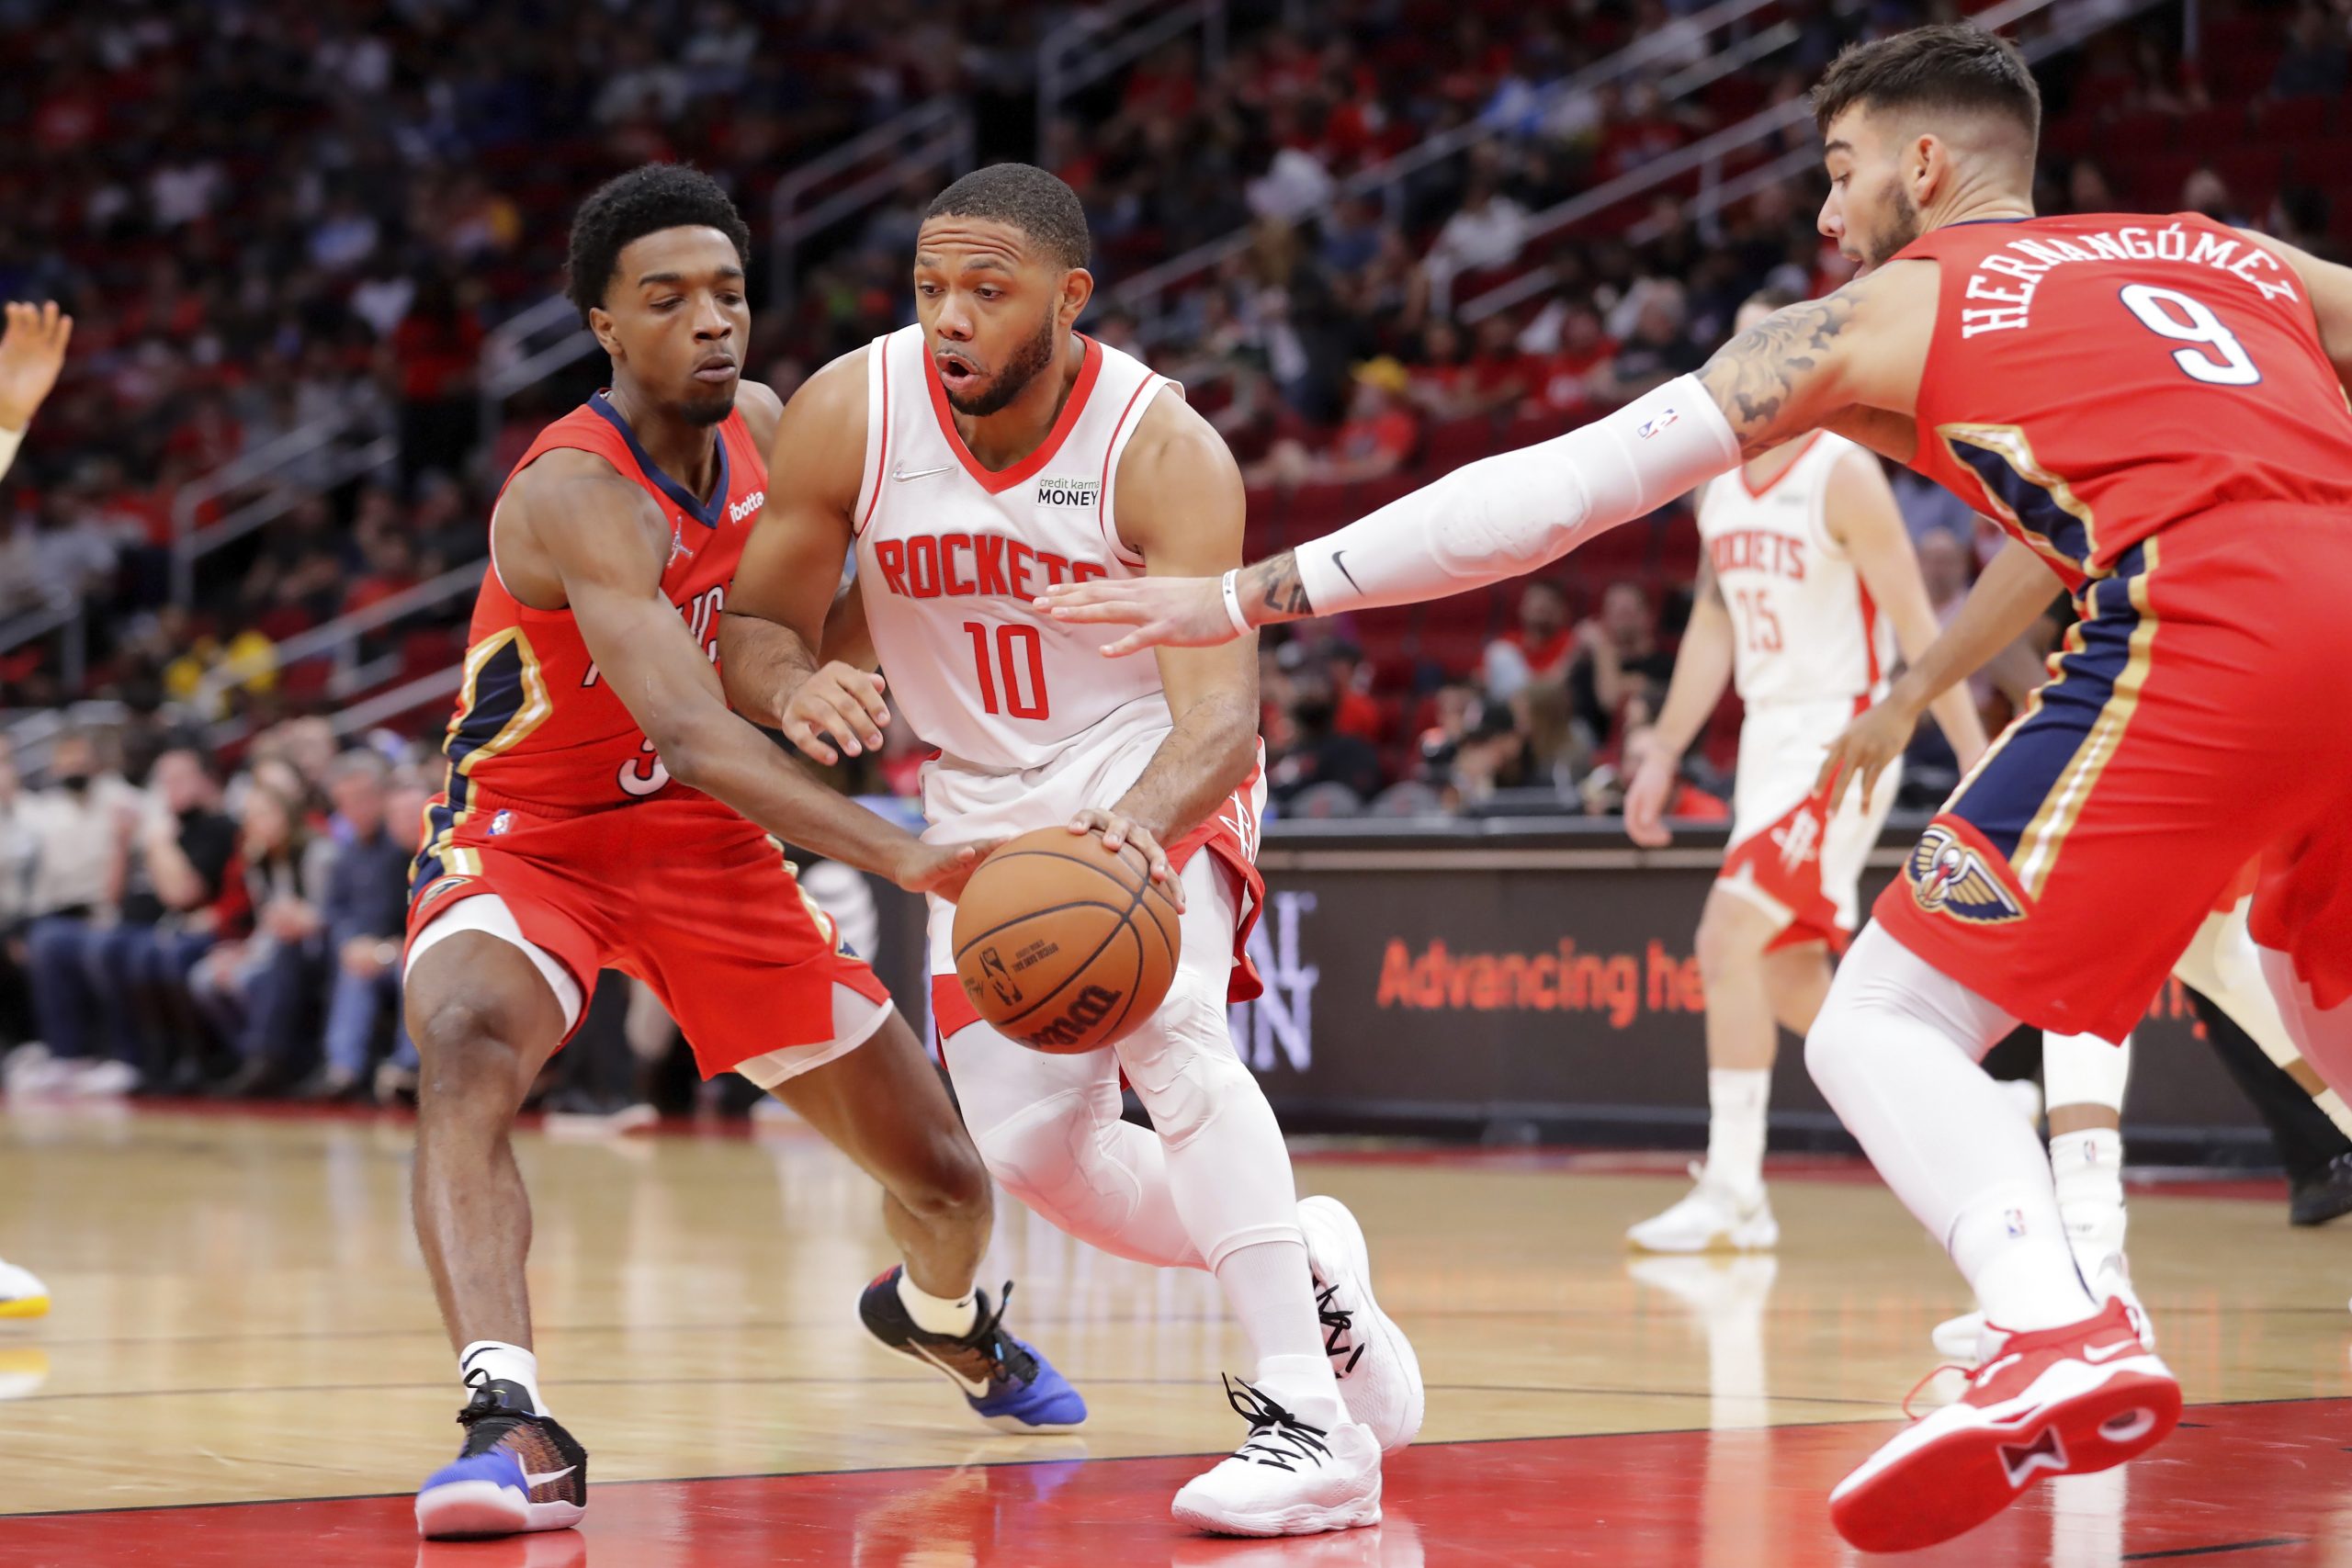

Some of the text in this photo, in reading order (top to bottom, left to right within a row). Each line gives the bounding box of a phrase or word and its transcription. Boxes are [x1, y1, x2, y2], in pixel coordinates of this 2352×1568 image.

[1962, 222, 2300, 339] HERNANGÓMEZ
[2119, 282, 2263, 387] 9
[729, 491, 764, 525] ibotta
[1037, 488, 1099, 506] MONEY
[1039, 478, 1069, 490] credit
[1736, 589, 1784, 652] 15
[964, 621, 1049, 720] 10
[1377, 937, 1639, 1029] Advancing
